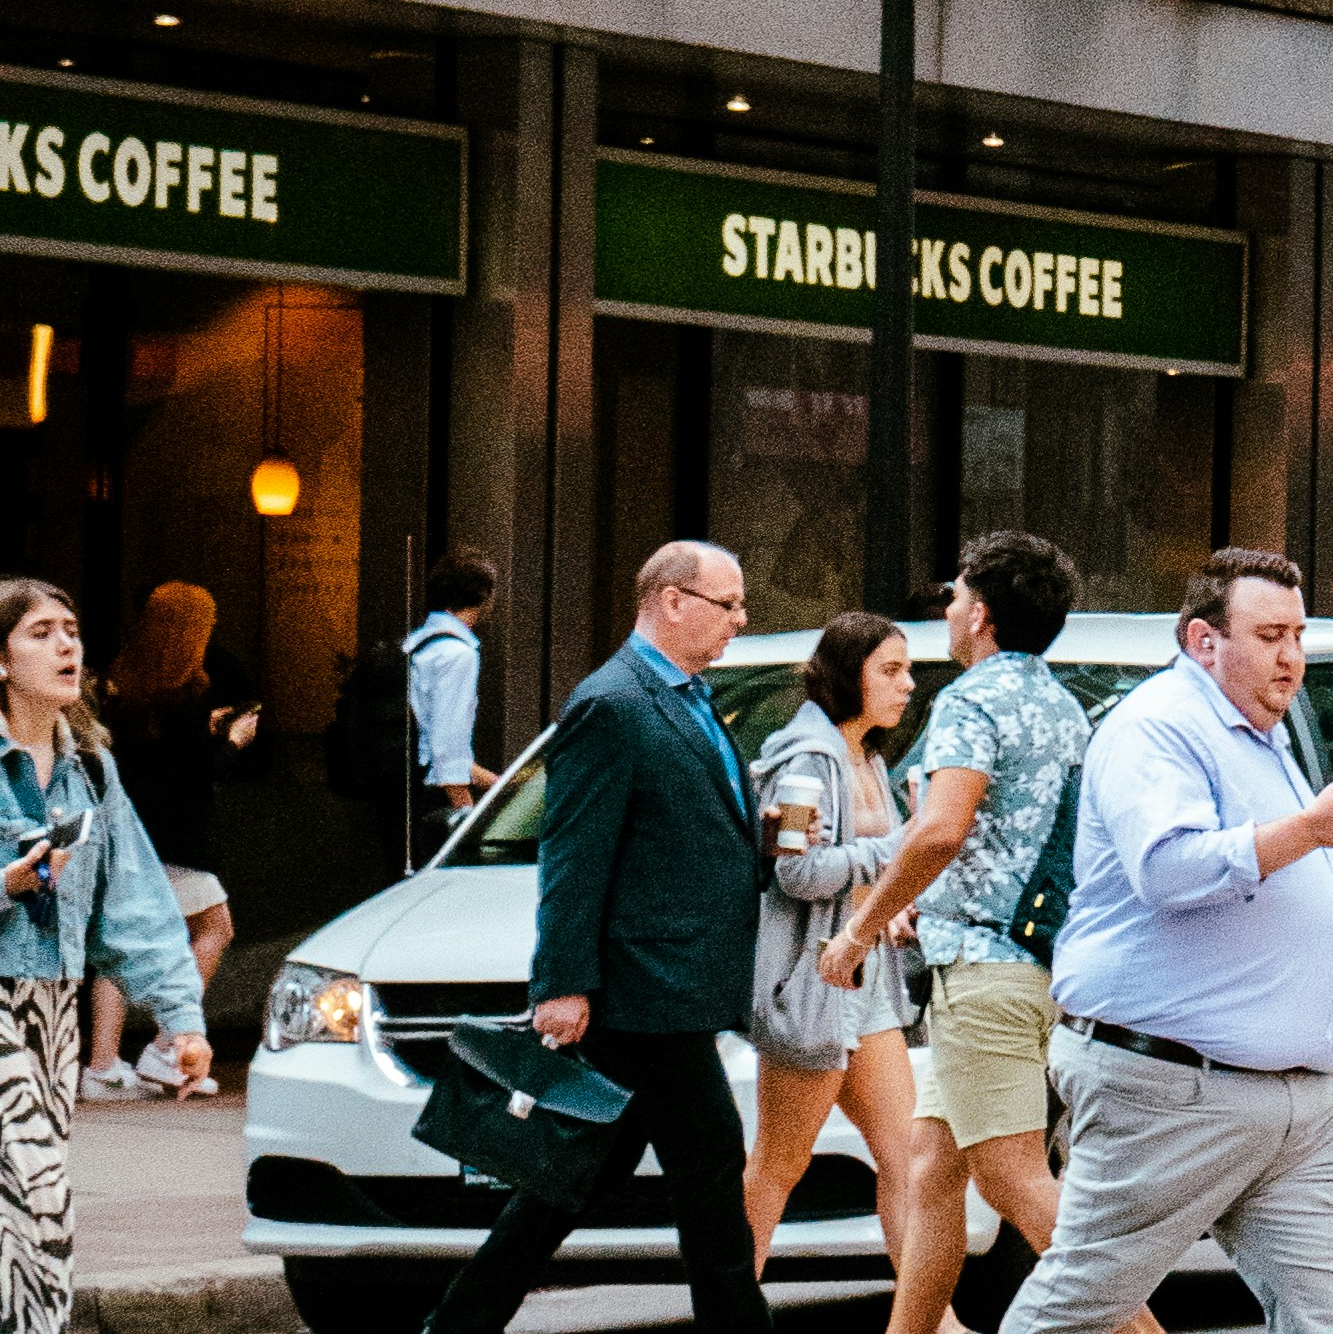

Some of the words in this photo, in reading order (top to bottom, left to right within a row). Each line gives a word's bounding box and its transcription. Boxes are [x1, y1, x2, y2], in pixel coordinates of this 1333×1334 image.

[79, 130, 279, 224] COFFEE
[721, 213, 972, 303] STARBKS
[979, 245, 1123, 319] COFFEE
